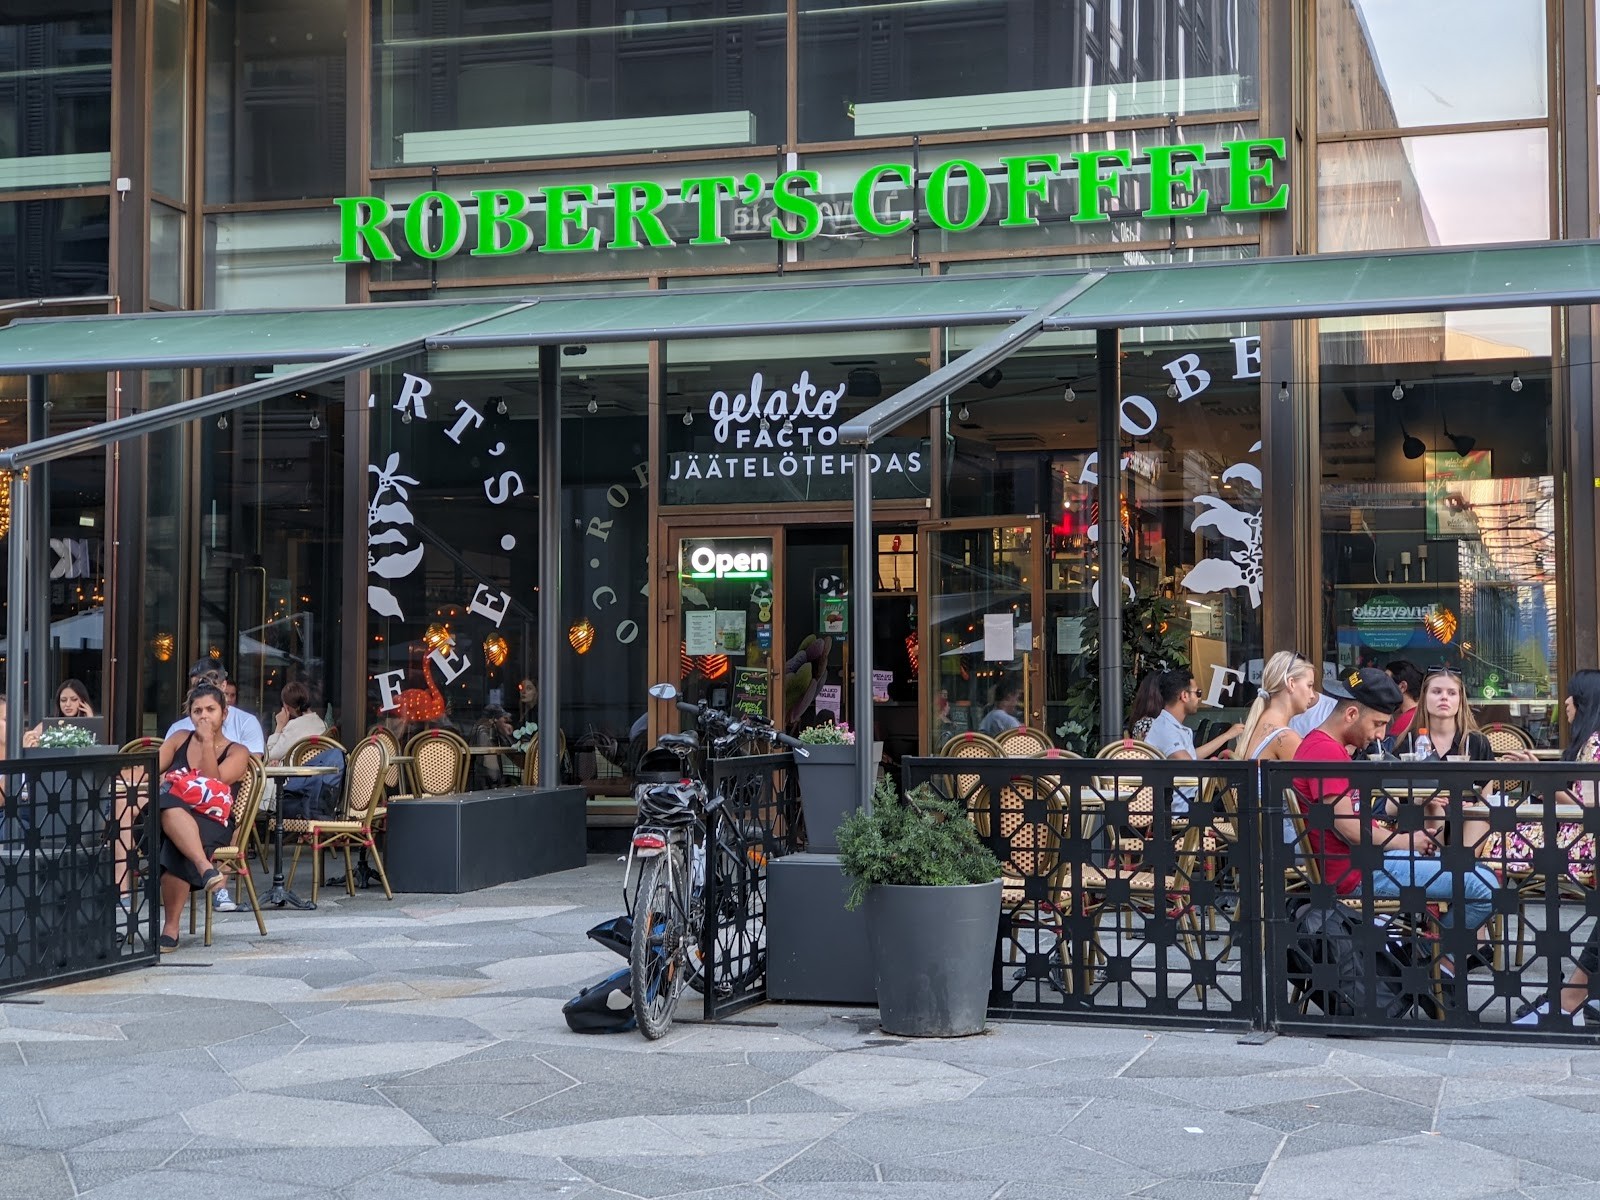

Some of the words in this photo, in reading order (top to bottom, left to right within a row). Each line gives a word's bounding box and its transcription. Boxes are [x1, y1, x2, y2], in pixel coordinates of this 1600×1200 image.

[333, 169, 824, 264] ROBERT'S
[852, 137, 1290, 237] COFFEE
[708, 370, 846, 444] gelato
[670, 451, 922, 480] JÄÄTELÖTEHDAS
[691, 547, 768, 579] Open
